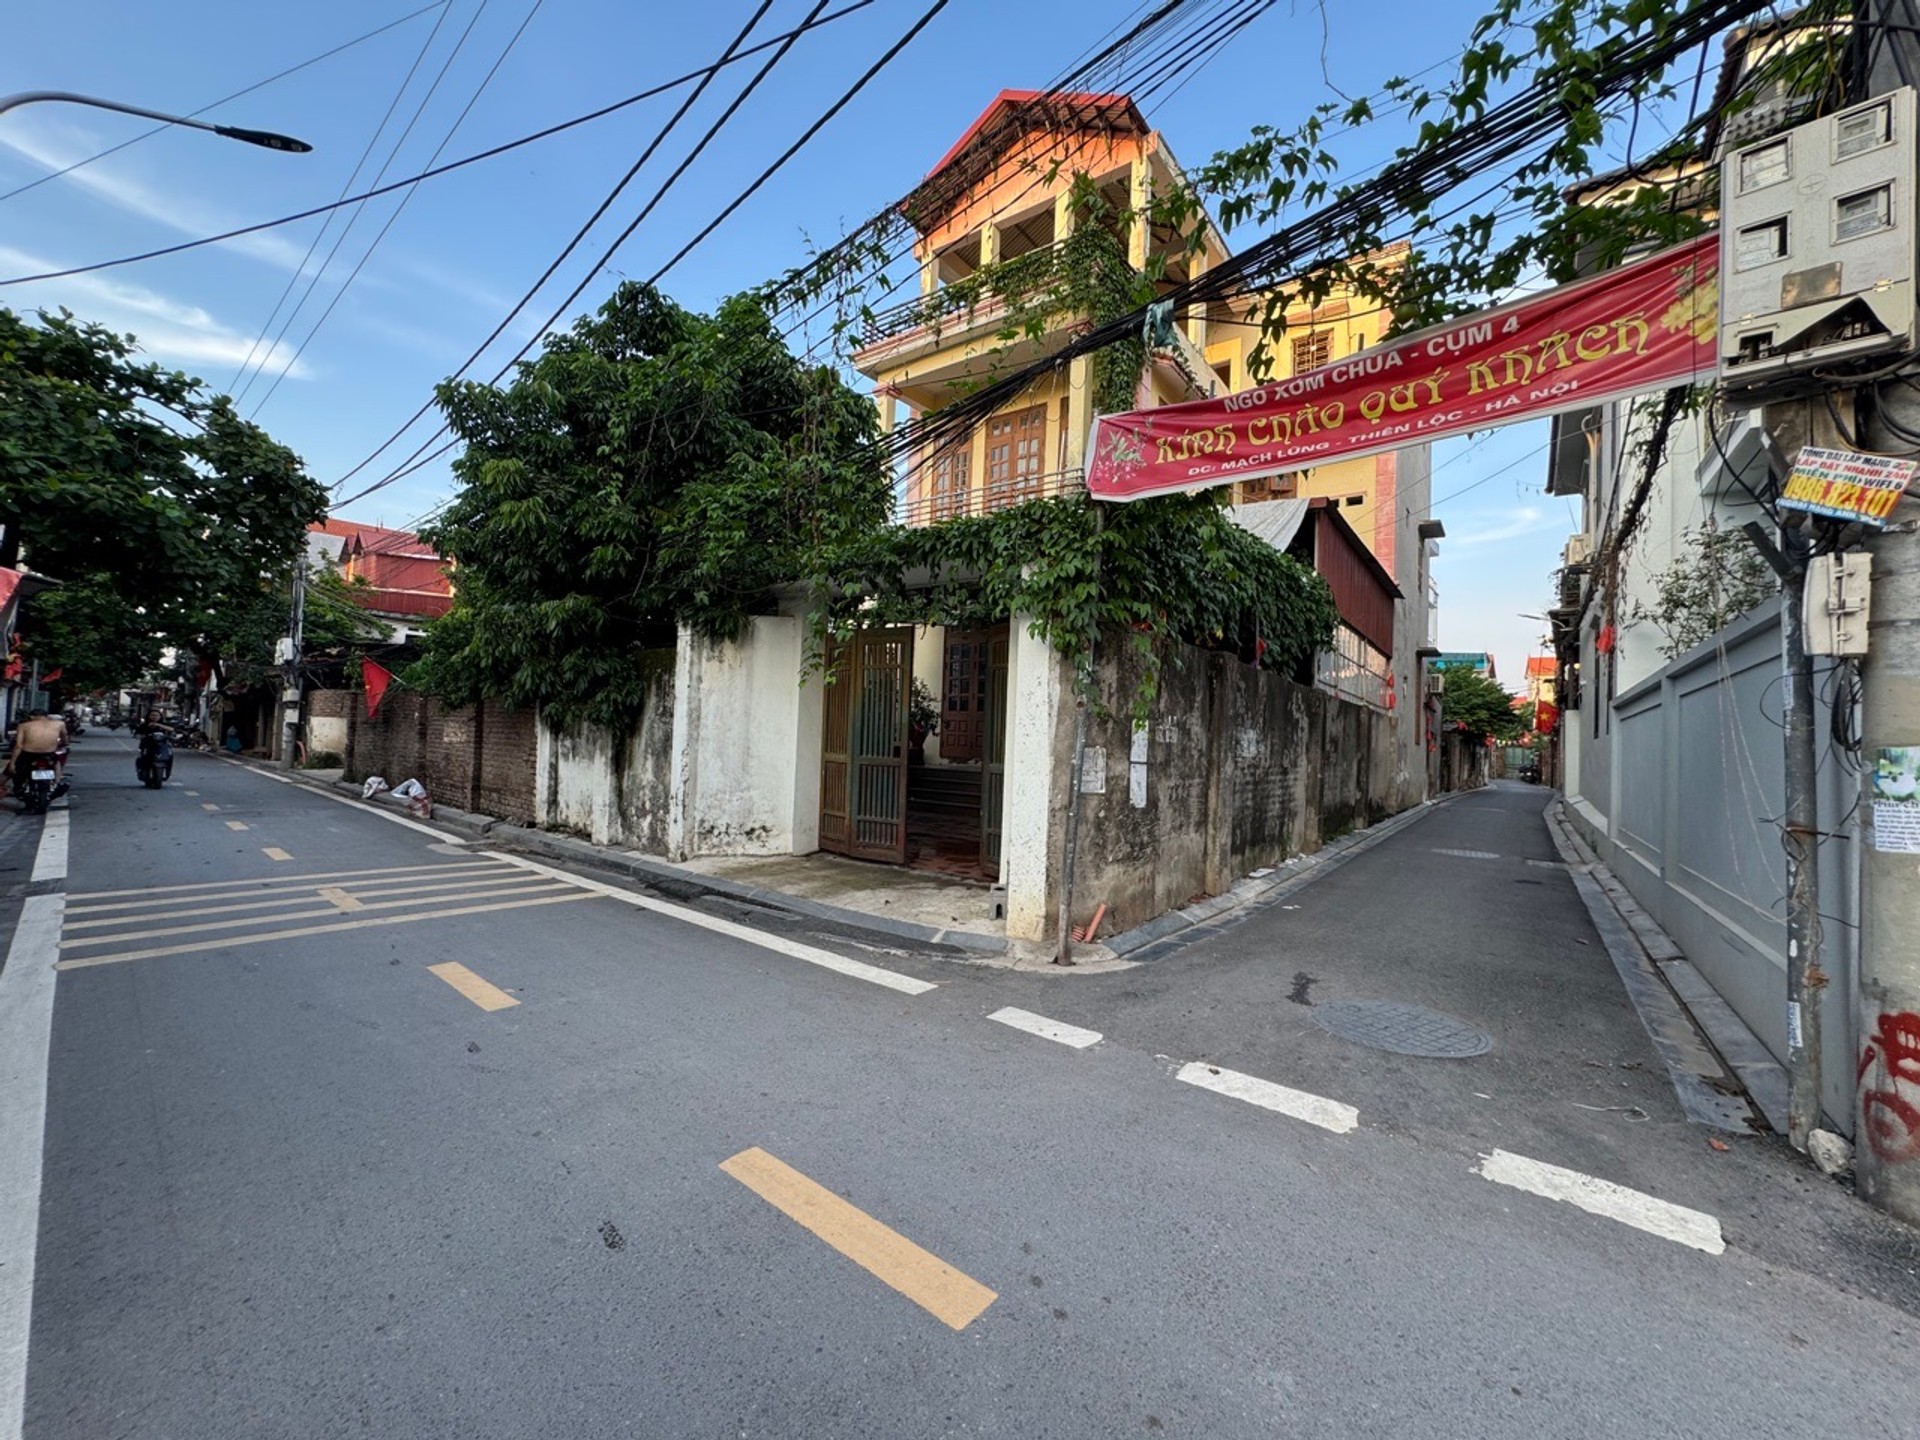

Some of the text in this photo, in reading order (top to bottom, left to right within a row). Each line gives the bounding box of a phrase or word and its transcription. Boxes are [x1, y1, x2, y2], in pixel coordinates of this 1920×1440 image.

[1426, 322, 1493, 356] CỤM
[1502, 314, 1520, 334] 4
[1155, 311, 1650, 464] KÍNH CHÀO QUÝ KHÁCH
[1221, 452, 1271, 470] MẠCH
[1348, 422, 1410, 443] THIÊN
[1417, 410, 1463, 428] LỘC
[1485, 394, 1521, 412] HÀ
[1530, 380, 1579, 400] NỘI
